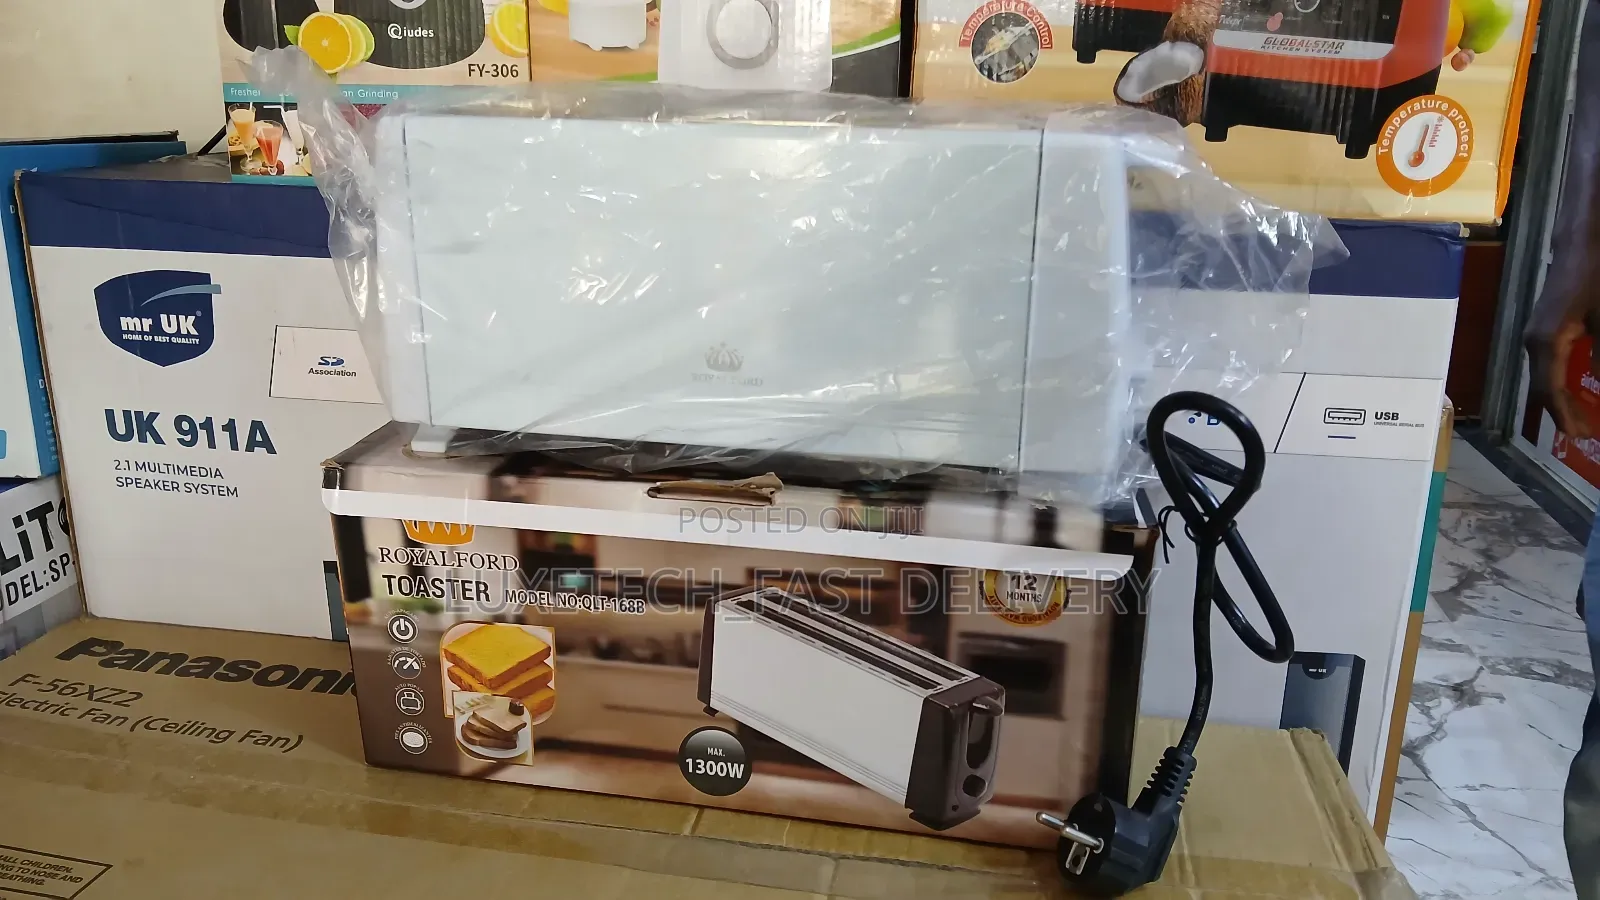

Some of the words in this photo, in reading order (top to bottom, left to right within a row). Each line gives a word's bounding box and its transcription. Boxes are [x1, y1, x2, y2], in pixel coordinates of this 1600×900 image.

[387, 23, 434, 40] Qiudes
[1026, 7, 1051, 48] Control
[468, 63, 519, 78] FY-306
[357, 89, 399, 99] Grinding
[1379, 99, 1449, 155] Temperature
[1448, 108, 1471, 157] protect
[120, 316, 153, 332] mr
[160, 313, 199, 336] UK
[171, 336, 200, 345] QUALITY
[308, 367, 357, 377] Association
[1374, 411, 1400, 421] USB
[104, 408, 166, 446] UK
[173, 414, 278, 455] 911A
[113, 459, 131, 472] 2.1
[135, 461, 224, 479] MULTIMEDIA
[116, 476, 181, 494] SPEAKER
[184, 480, 239, 497] SYSTEM
[378, 547, 520, 571] ROYALFORD
[1010, 574, 1038, 592] 12
[382, 574, 491, 603] TOASTER
[505, 588, 553, 607] MODEL
[556, 593, 646, 615] NO:QLT-168B
[1006, 590, 1042, 603] MONTHS
[54, 637, 357, 699] Panasoni
[8, 673, 144, 708] F-56XZ2
[77, 707, 130, 727] Fan
[129, 715, 237, 744] (Ceiling
[238, 729, 304, 753] Fan)
[707, 747, 726, 757] MAX.
[685, 758, 745, 779] 1300W
[30, 869, 61, 880] NOSE
[59, 874, 84, 884] AND
